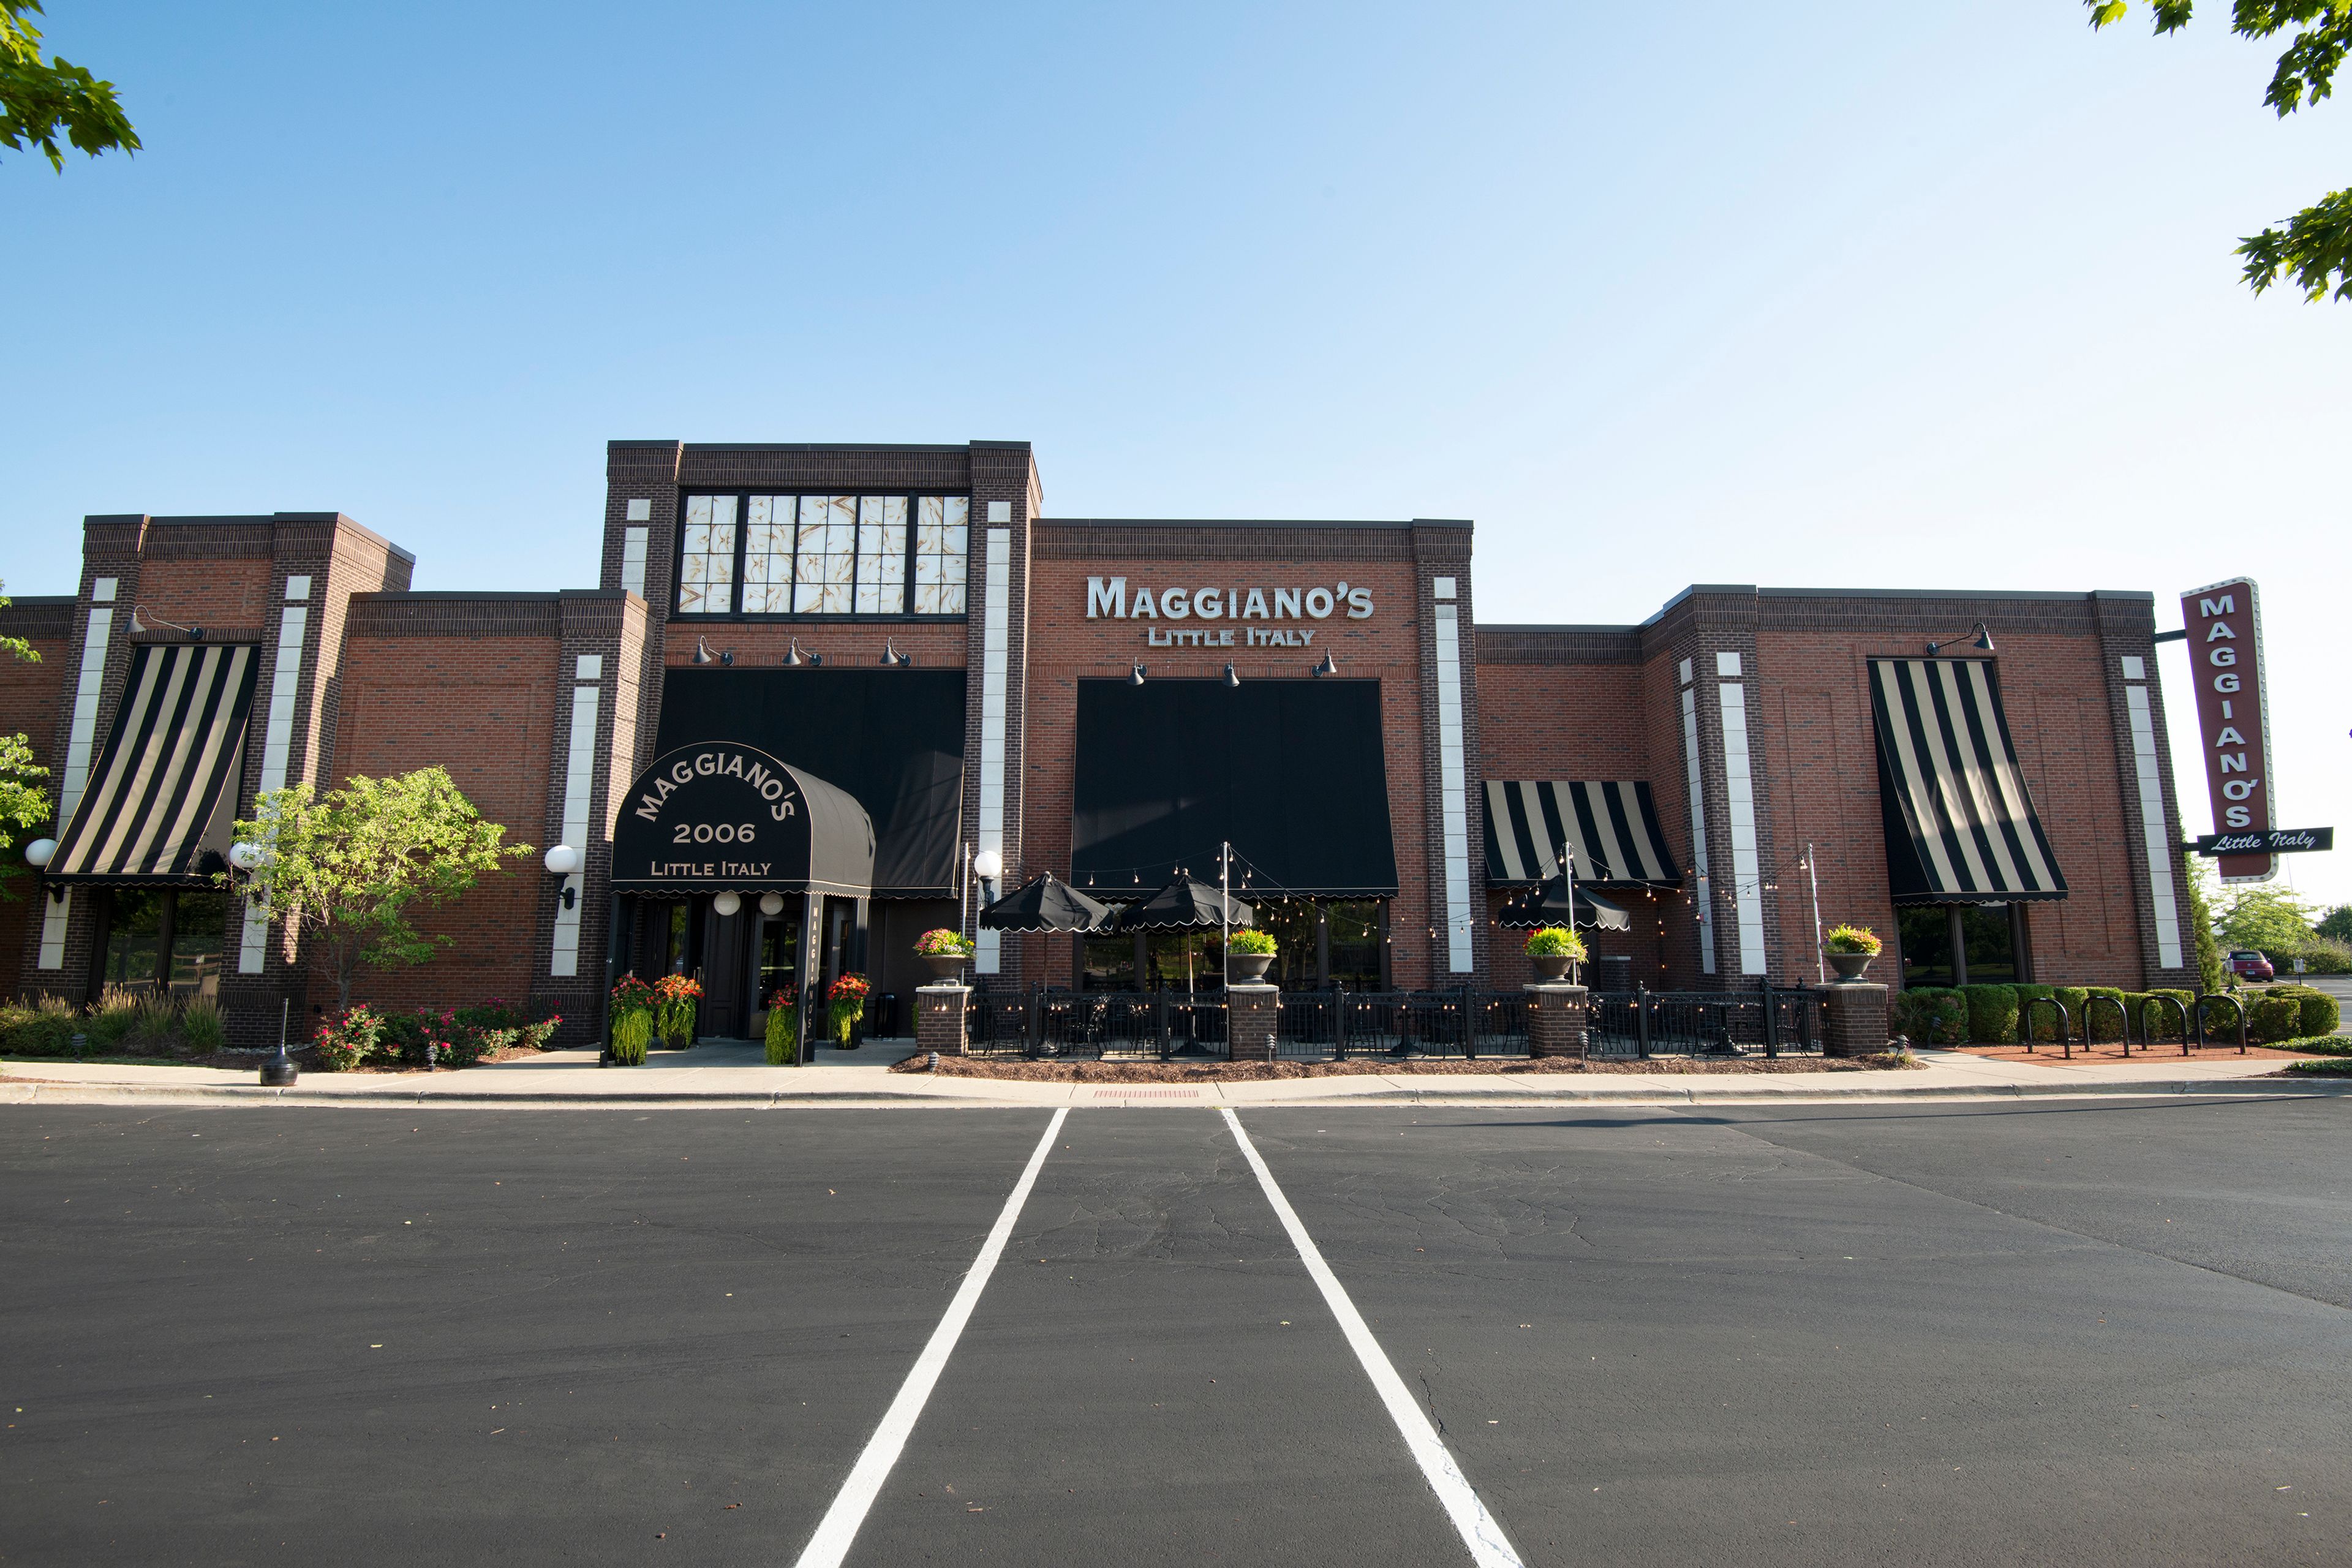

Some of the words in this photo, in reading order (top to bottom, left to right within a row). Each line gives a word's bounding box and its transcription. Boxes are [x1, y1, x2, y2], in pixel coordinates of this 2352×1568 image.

[1087, 576, 1374, 620] MAGGIANO'S
[1148, 627, 1235, 648] LITTLE
[1246, 627, 1316, 648] ITALY
[2199, 595, 2258, 828] MAGGIANO'S
[635, 753, 795, 823] MAGGIANO'S
[673, 823, 756, 843] 2006
[2211, 834, 2261, 851] Little
[2268, 831, 2316, 850] Italy
[650, 861, 715, 876] LITTLE
[722, 861, 772, 876] ITALY
[808, 907, 818, 1028] MAGGIANO'S
